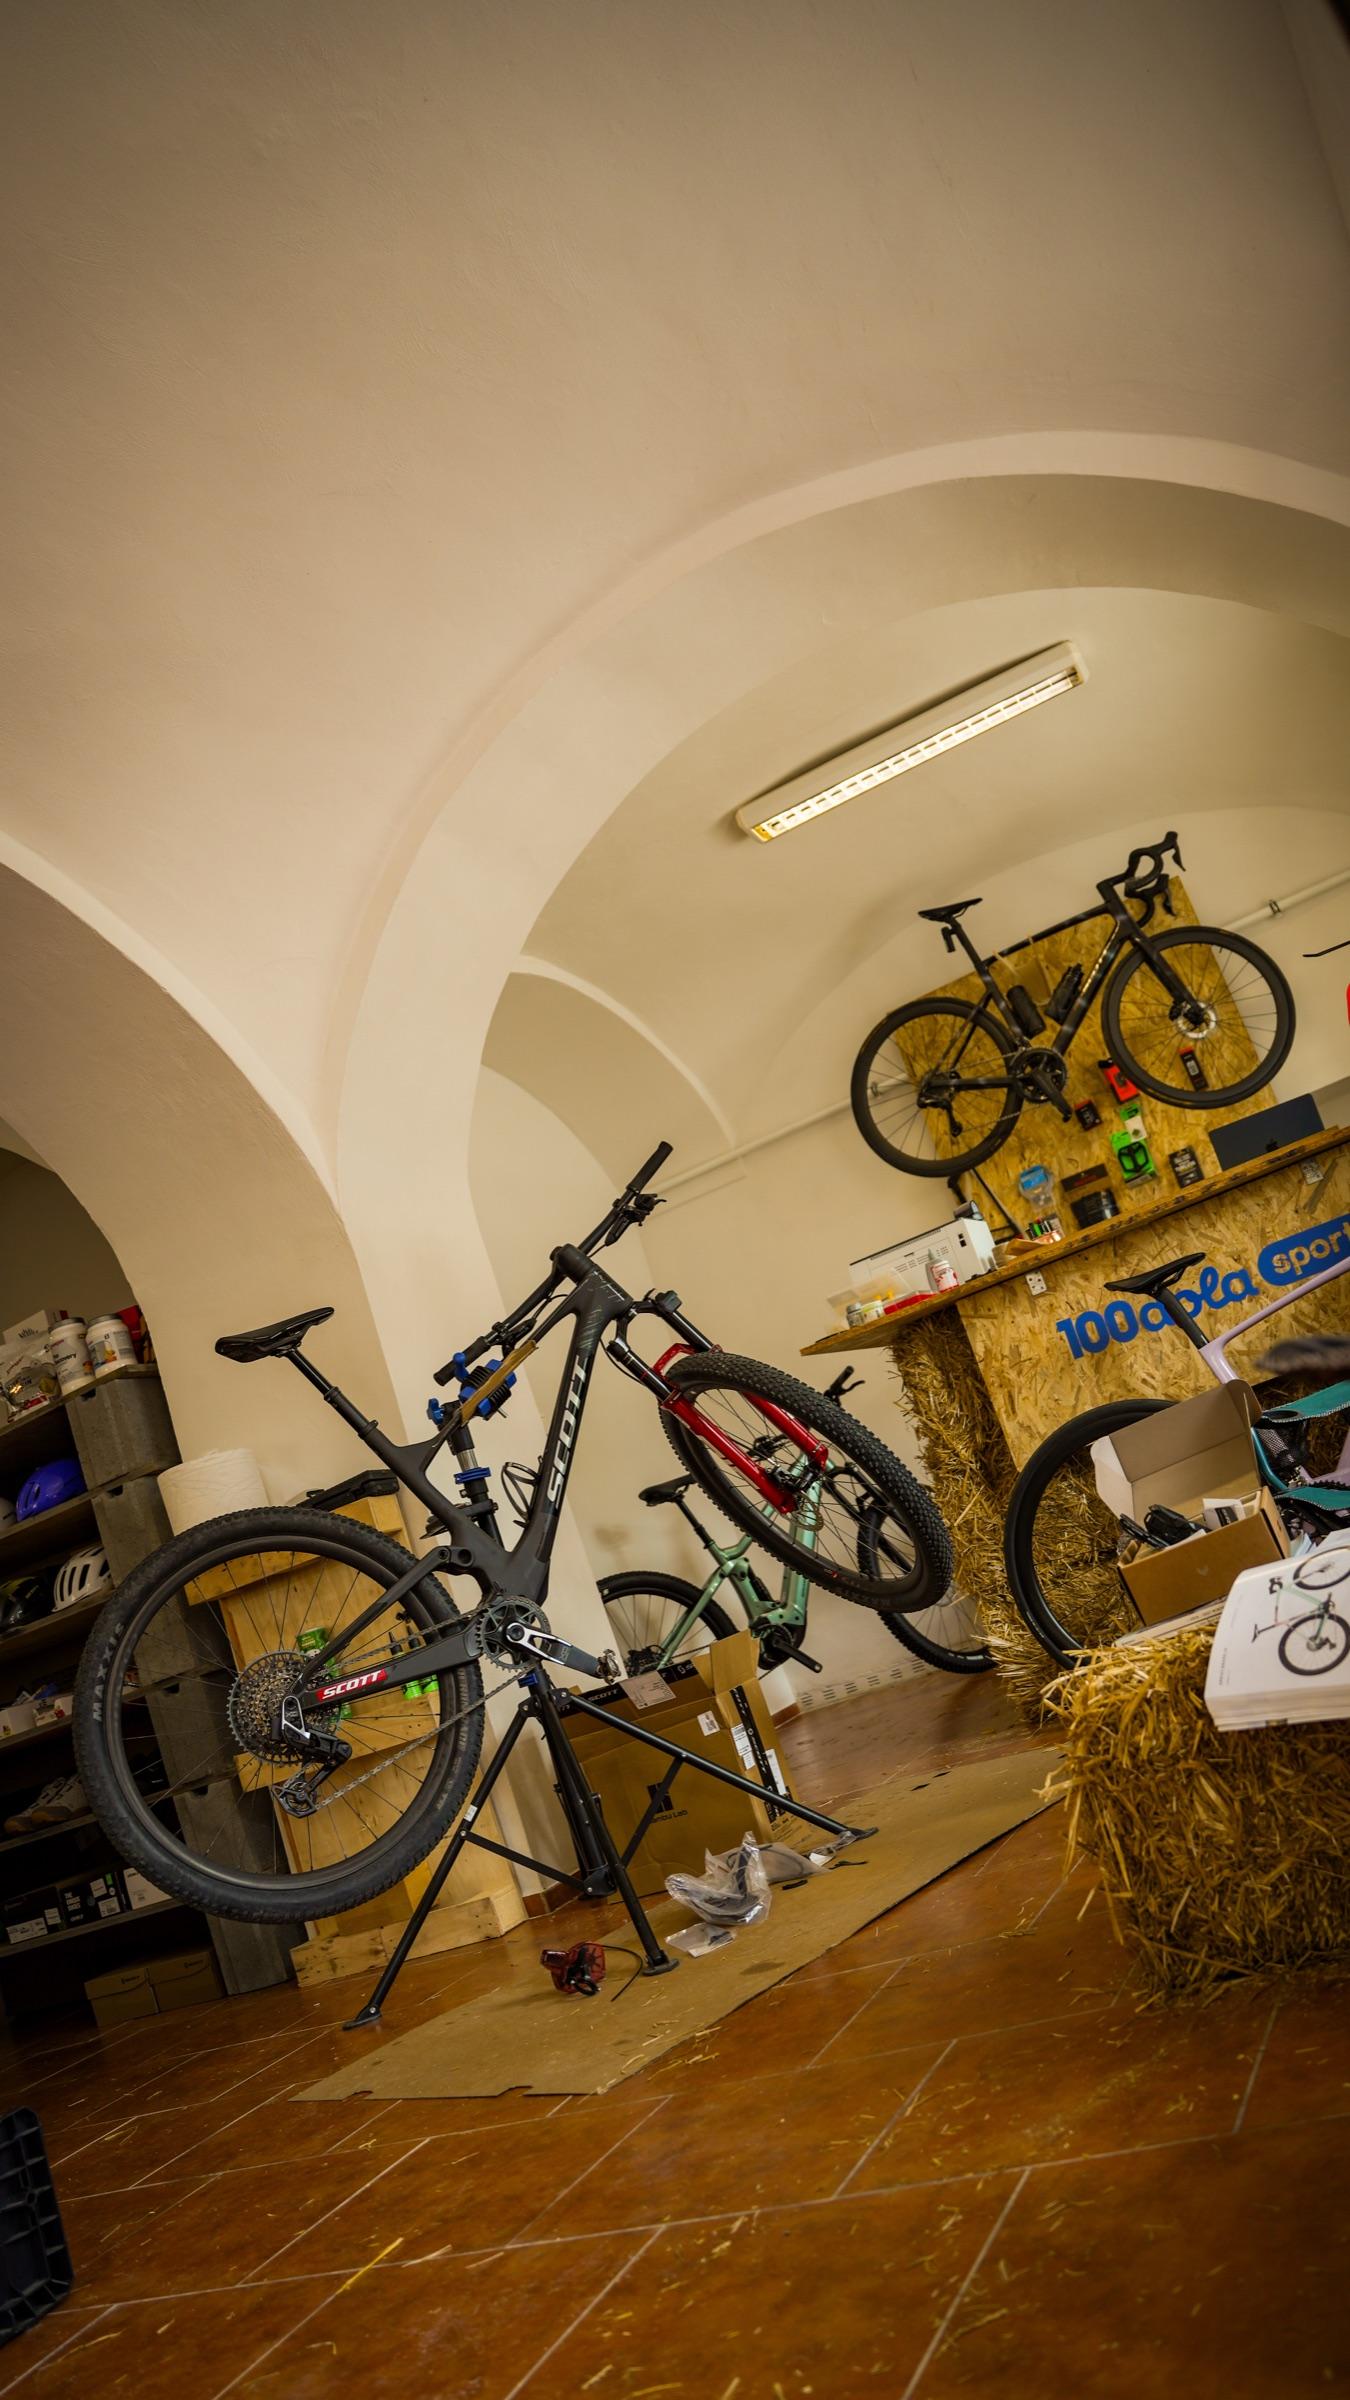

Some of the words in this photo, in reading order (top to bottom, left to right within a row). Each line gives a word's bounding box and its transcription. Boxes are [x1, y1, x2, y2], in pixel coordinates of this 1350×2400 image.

[547, 1354, 590, 1510] SCOTT
[92, 1622, 125, 1722] MAXXIS
[321, 1667, 386, 1700] SCOTT
